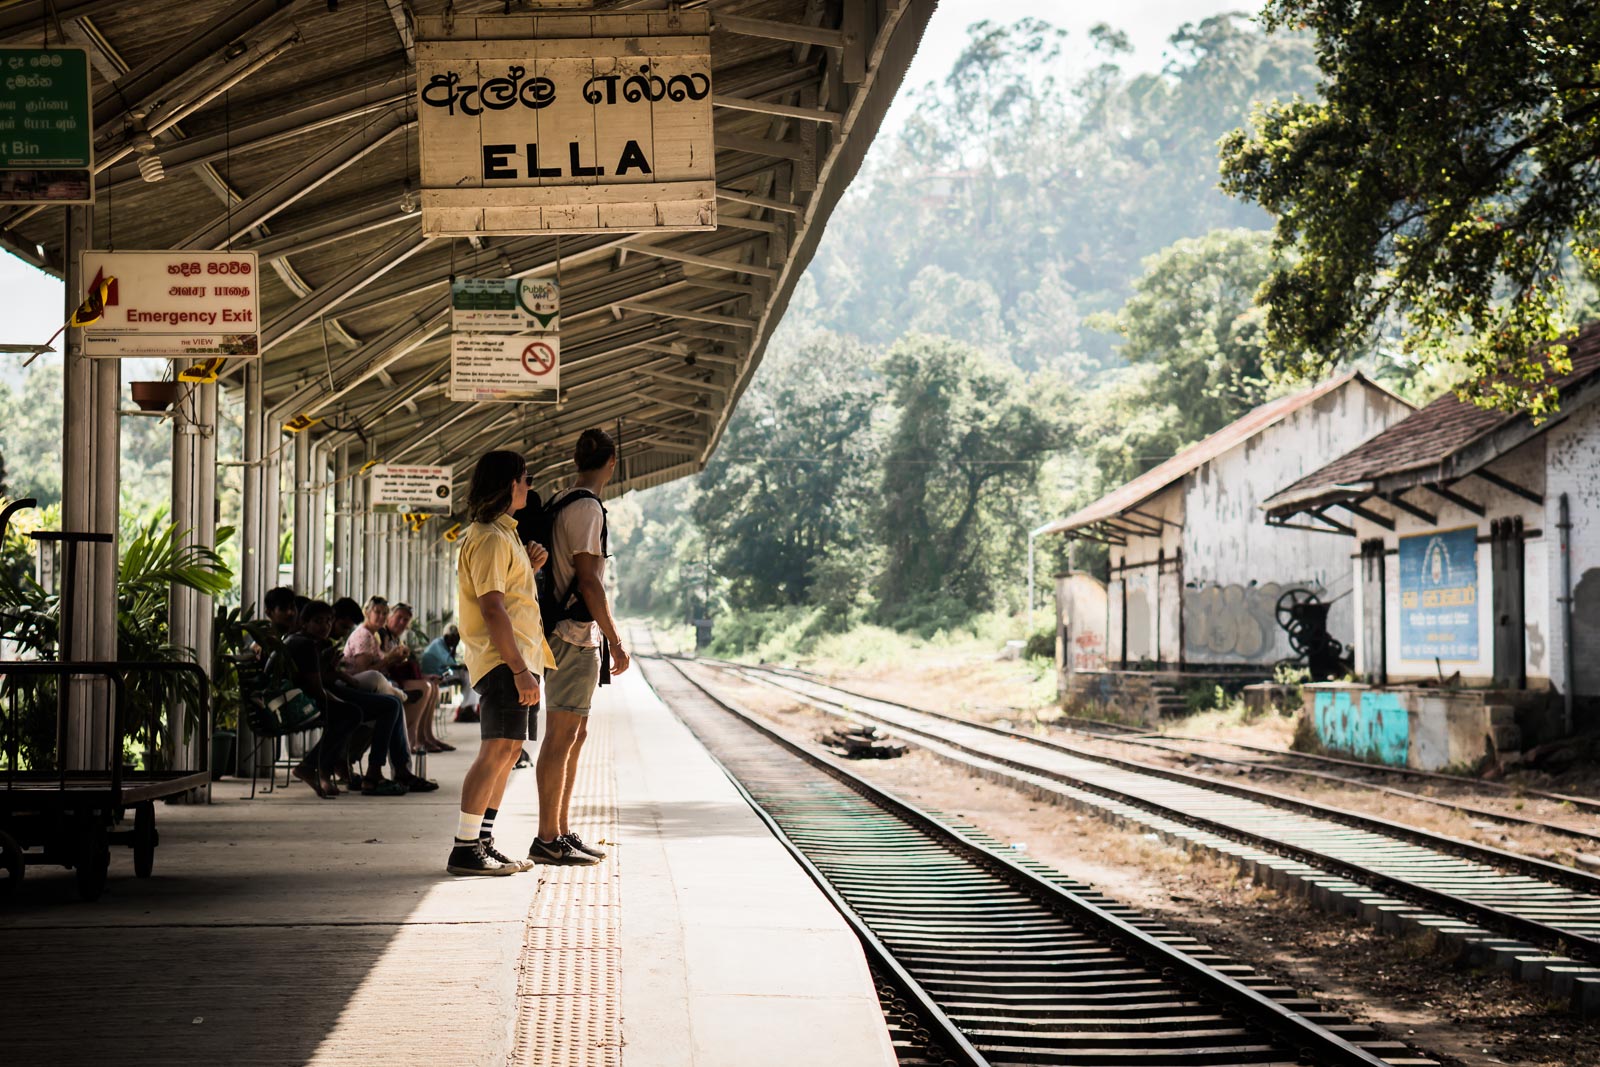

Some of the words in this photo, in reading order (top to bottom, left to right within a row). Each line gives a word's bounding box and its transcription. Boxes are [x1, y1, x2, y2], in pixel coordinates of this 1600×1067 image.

[421, 65, 557, 116] ඇල්ල
[582, 64, 711, 105] எல்ல
[12, 140, 39, 154] Bin
[483, 140, 652, 179] ELLA
[167, 262, 202, 277] හදිසි
[169, 286, 206, 298] அவசர
[214, 286, 250, 297] பாதை
[127, 309, 217, 325] Emergency
[222, 309, 253, 322] Exit
[439, 487, 446, 497] 2
